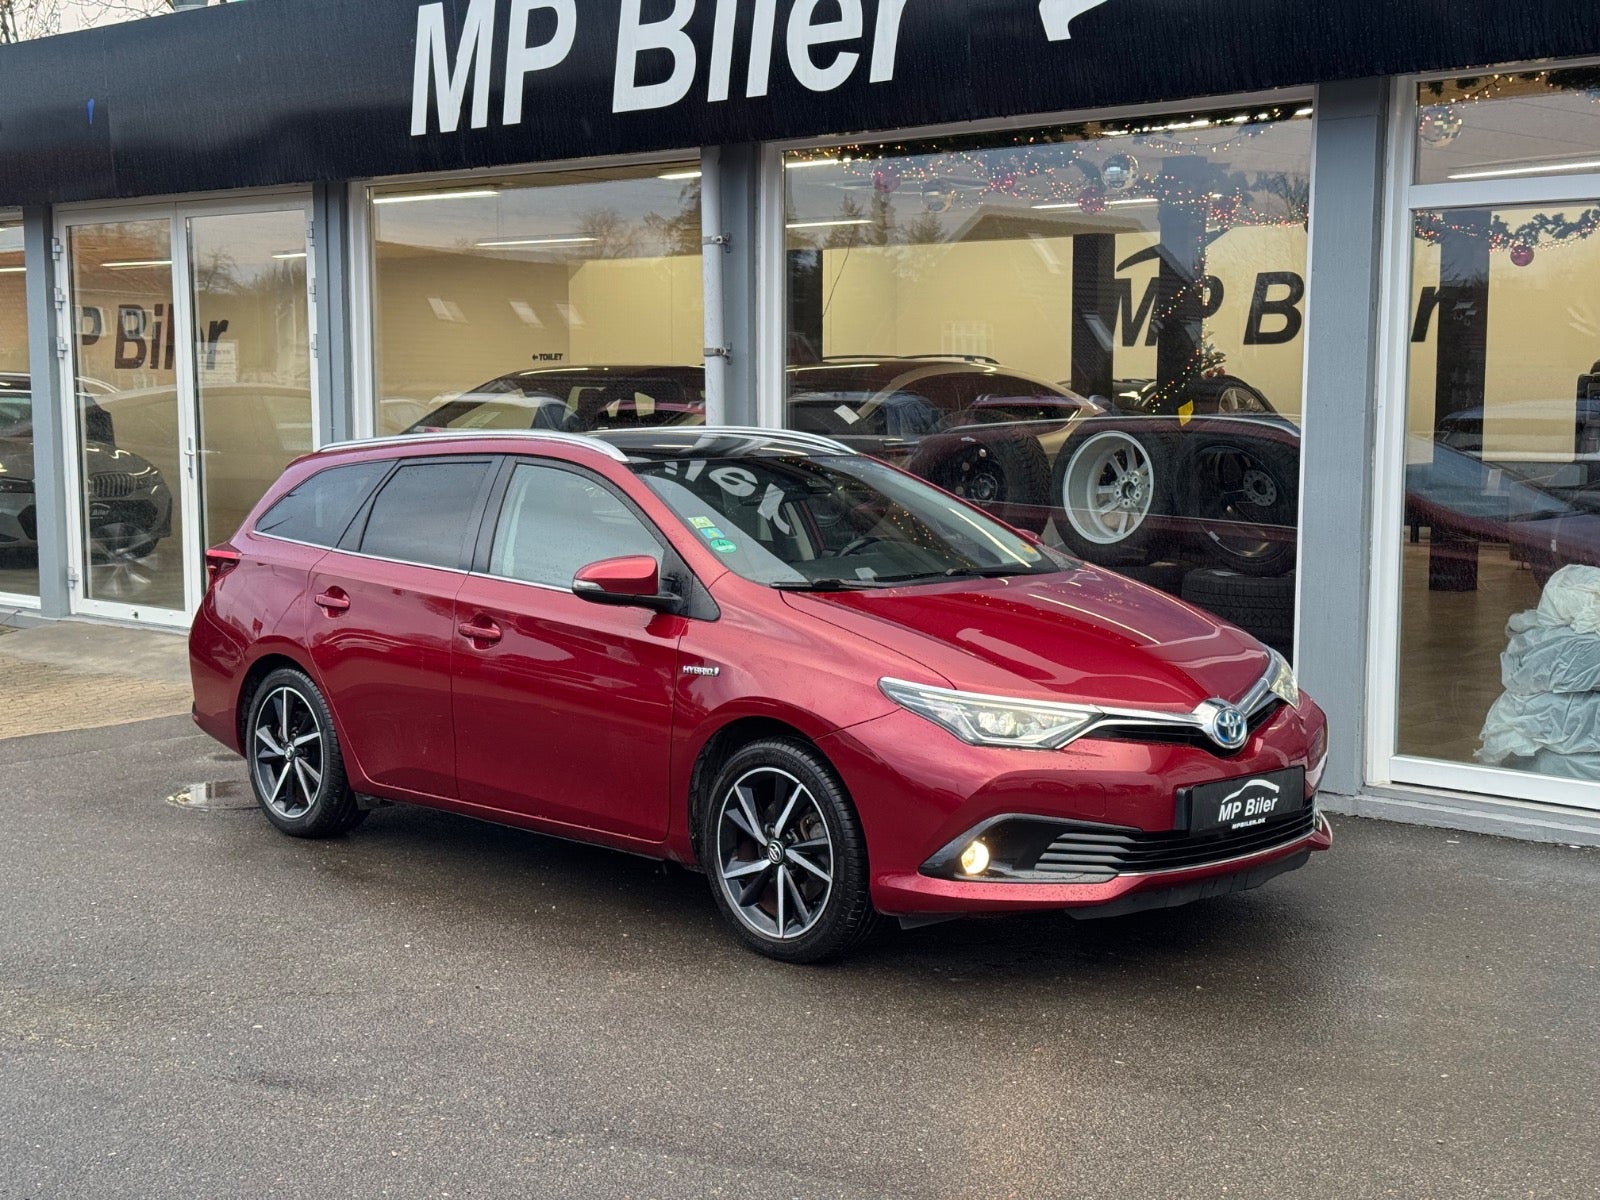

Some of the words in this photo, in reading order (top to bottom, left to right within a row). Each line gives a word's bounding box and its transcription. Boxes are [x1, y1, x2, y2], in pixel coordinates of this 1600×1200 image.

[411, 0, 577, 136] MP
[612, 0, 904, 113] Biler
[115, 303, 229, 370] Bilr
[683, 666, 713, 676] HYBRID
[1218, 802, 1242, 822] MP
[1245, 797, 1278, 816] Biler
